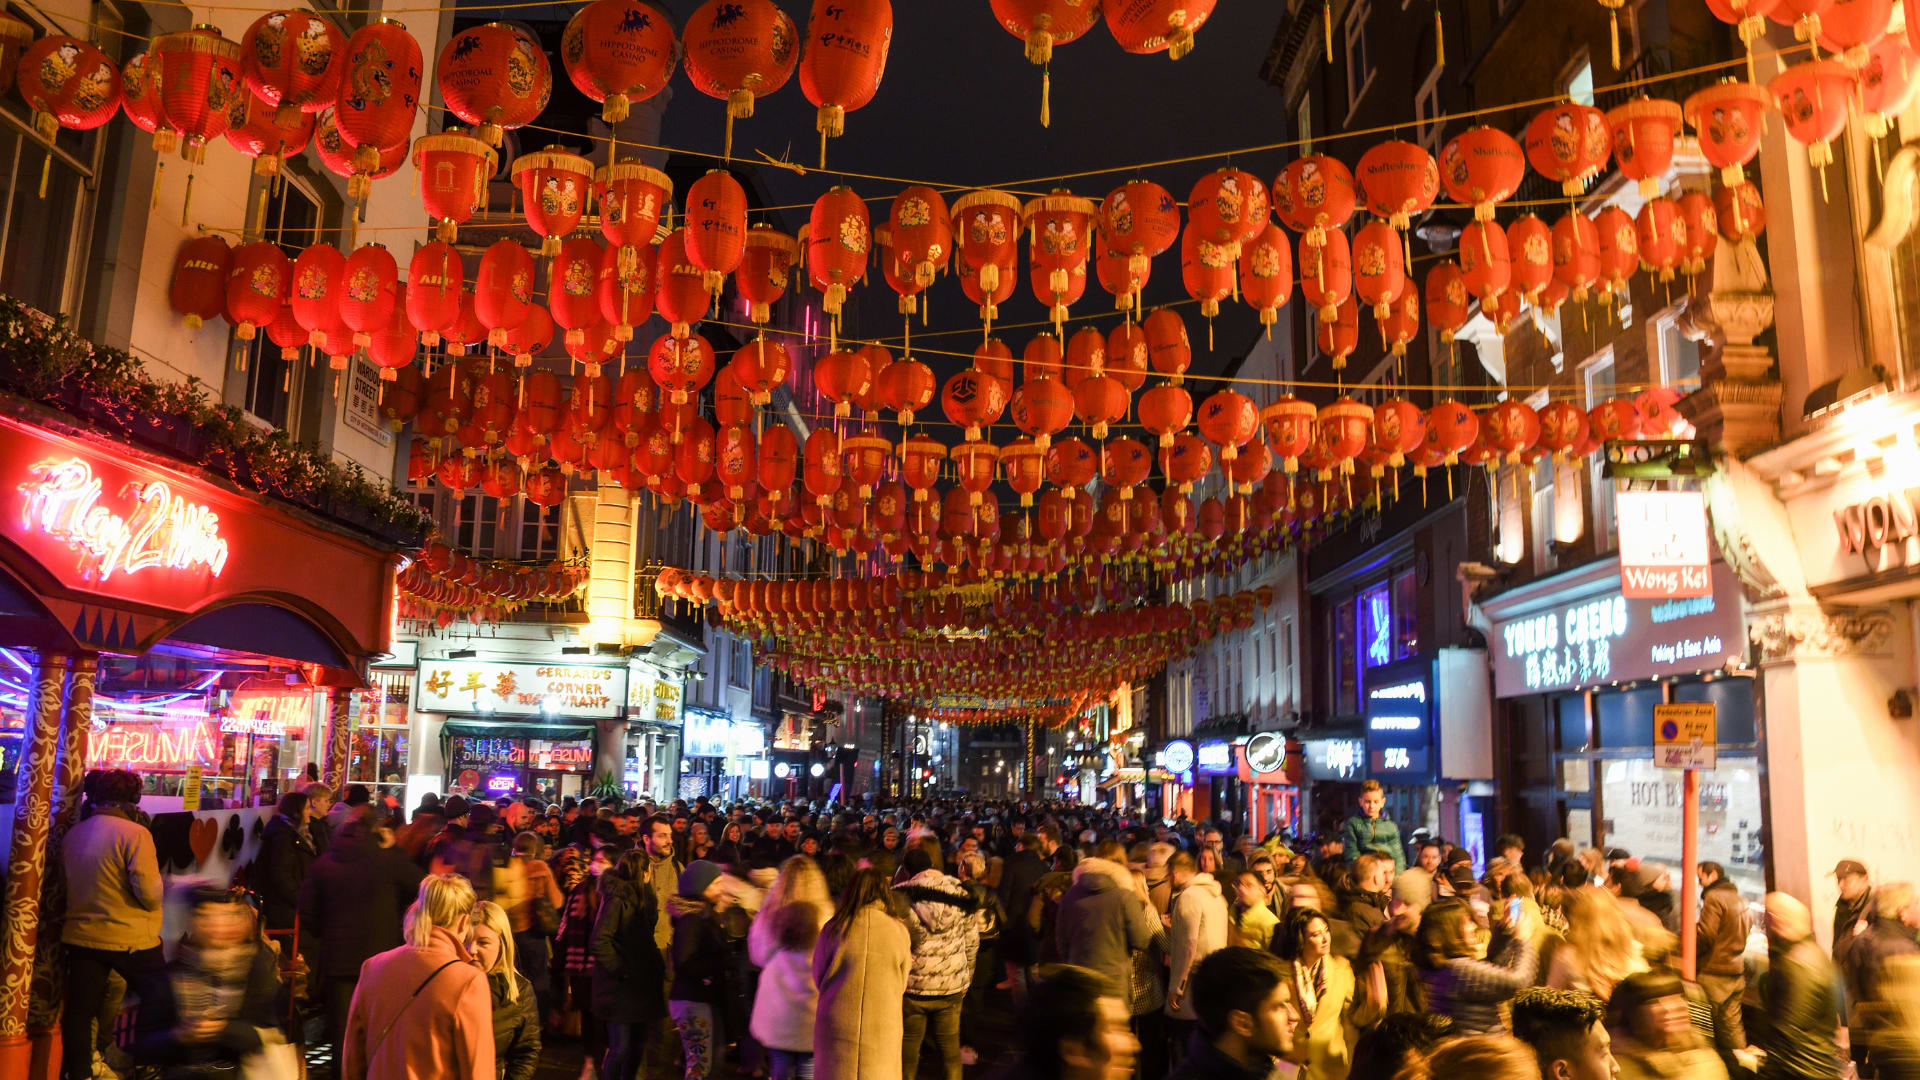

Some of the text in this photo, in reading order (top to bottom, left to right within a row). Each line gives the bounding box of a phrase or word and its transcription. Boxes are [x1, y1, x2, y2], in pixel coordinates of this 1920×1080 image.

[600, 40, 659, 57] HIPPODROME
[699, 38, 759, 48] HIPPODROME
[612, 50, 646, 62] CASINO
[710, 47, 745, 55] CASINO
[443, 69, 493, 82] HIPPODROME
[451, 78, 481, 88] CASINO
[357, 359, 382, 387] WARDOU
[354, 377, 376, 400] STREET
[38, 457, 130, 581] Play
[124, 481, 172, 575] 2
[1625, 567, 1708, 594] Wong Kei
[1503, 613, 1558, 657] YOUNG
[1703, 634, 1722, 655] Asia
[536, 666, 612, 680] GERRARD'S
[425, 670, 519, 700] 好年華
[547, 682, 602, 694] CORNER
[1695, 706, 1713, 716] Zone
[1695, 722, 1708, 731] any
[464, 751, 486, 761] DIM
[489, 780, 514, 788] OPEN
[1631, 782, 1660, 808] HOT
